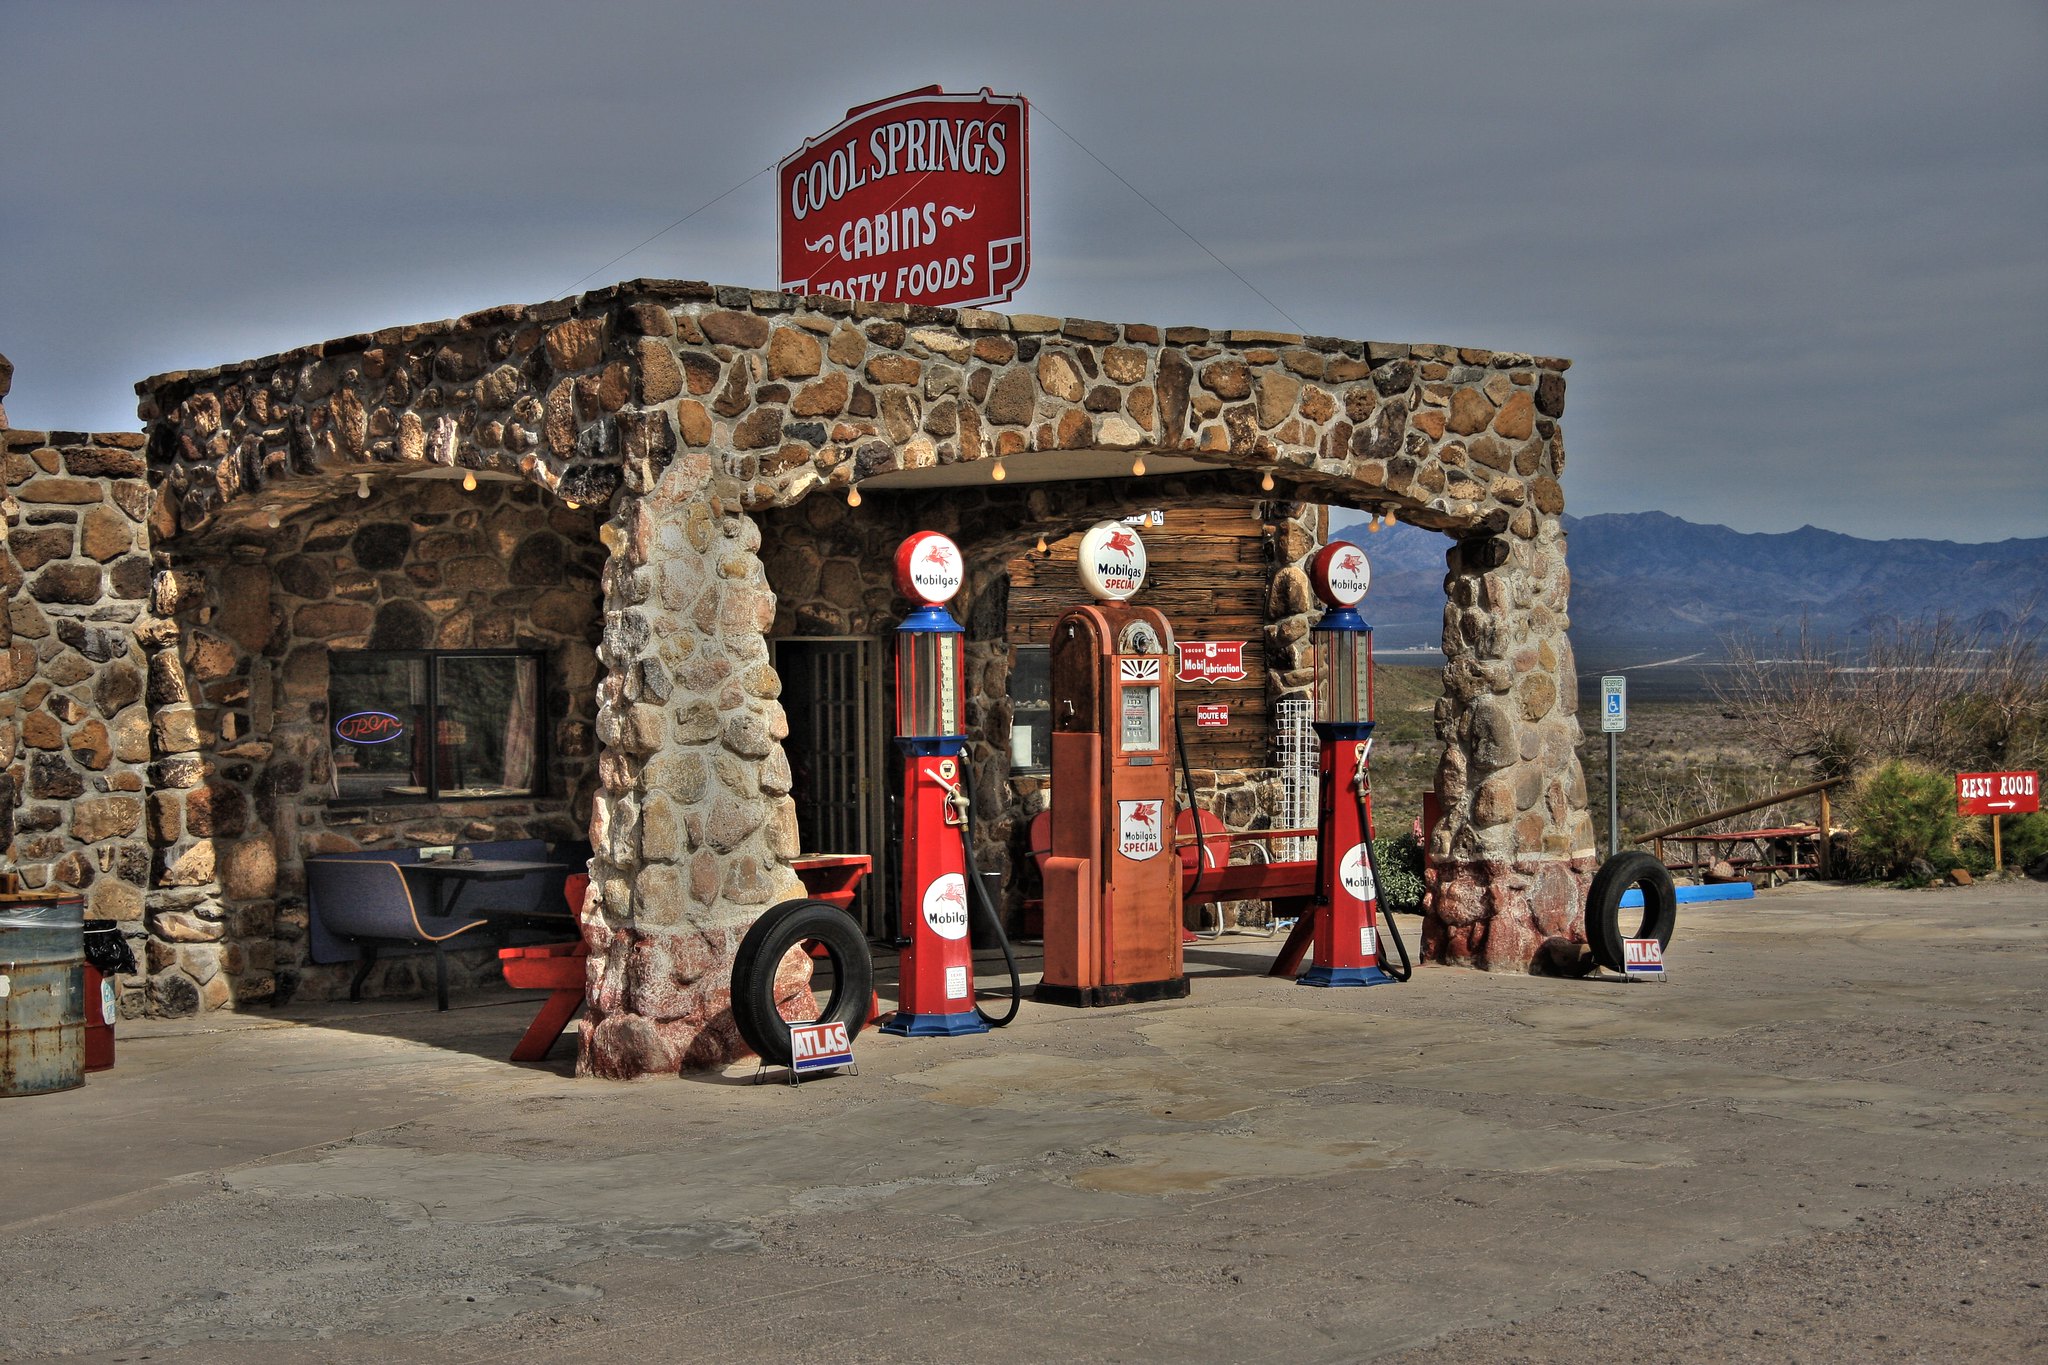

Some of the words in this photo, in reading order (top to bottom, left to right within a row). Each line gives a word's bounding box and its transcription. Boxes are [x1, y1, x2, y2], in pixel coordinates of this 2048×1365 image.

[792, 139, 866, 220] COOL
[869, 119, 1006, 181] SPRINGS
[839, 202, 936, 261] CABINS
[895, 254, 975, 298] FOODS
[1098, 563, 1141, 580] Mobilgas
[915, 574, 959, 588] Mobilgas
[1105, 579, 1136, 590] SPECIAL
[1331, 579, 1367, 592] Mobilgas
[1198, 712, 1219, 720] ROUTE
[1219, 712, 1228, 720] 66
[1961, 778, 1992, 798] REST
[1999, 775, 2033, 795] ROOM
[1125, 831, 1157, 842] Mobilgas
[1124, 842, 1158, 852] SPECIAL
[1345, 876, 1374, 888] Mobilg
[929, 911, 967, 925] Mobilg
[1626, 943, 1661, 962] ATLAS
[794, 1026, 848, 1057] ATLAS
